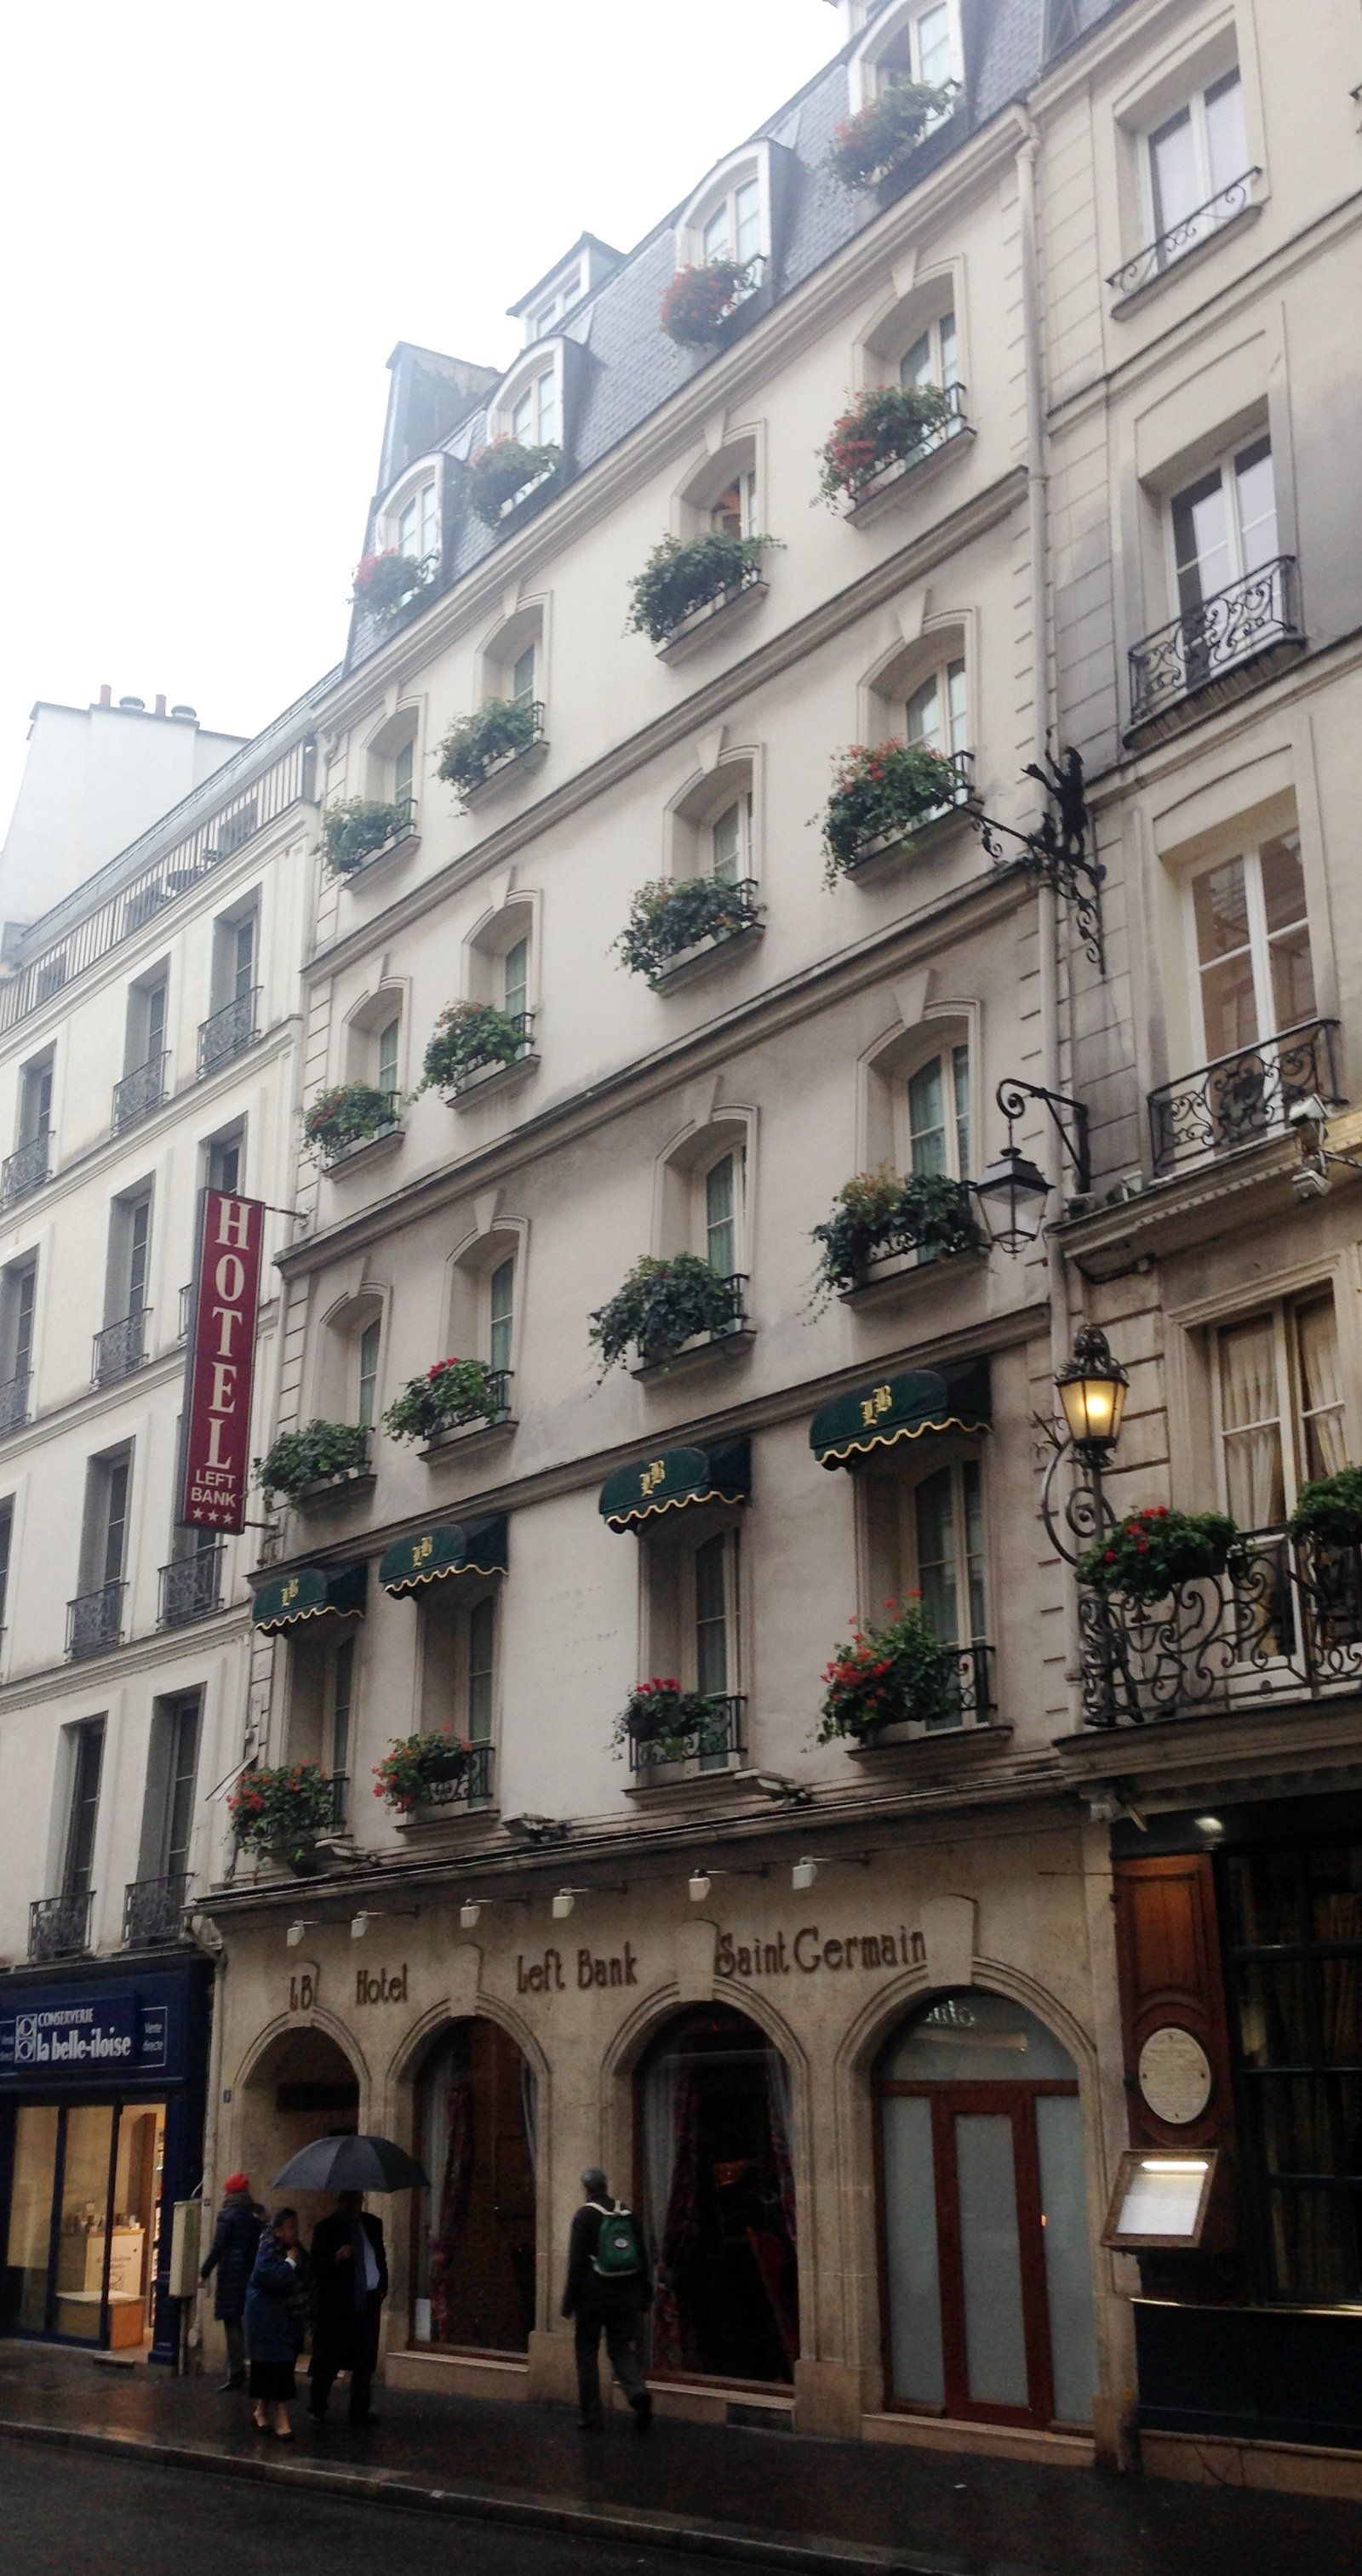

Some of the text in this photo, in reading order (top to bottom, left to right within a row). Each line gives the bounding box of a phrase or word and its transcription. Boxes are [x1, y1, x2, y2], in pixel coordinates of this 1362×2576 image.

[204, 1197, 254, 1470] HOTEL
[195, 1470, 236, 1489] LEFT
[191, 1487, 237, 1508] BANK
[355, 1962, 409, 2006] Hotel
[516, 1948, 567, 1994] Left
[577, 1941, 638, 1990] Bank
[714, 1933, 790, 1978] Saint
[793, 1925, 928, 1974] Germain
[38, 2008, 94, 2027] CONSERVERIE
[37, 2033, 50, 2061] la
